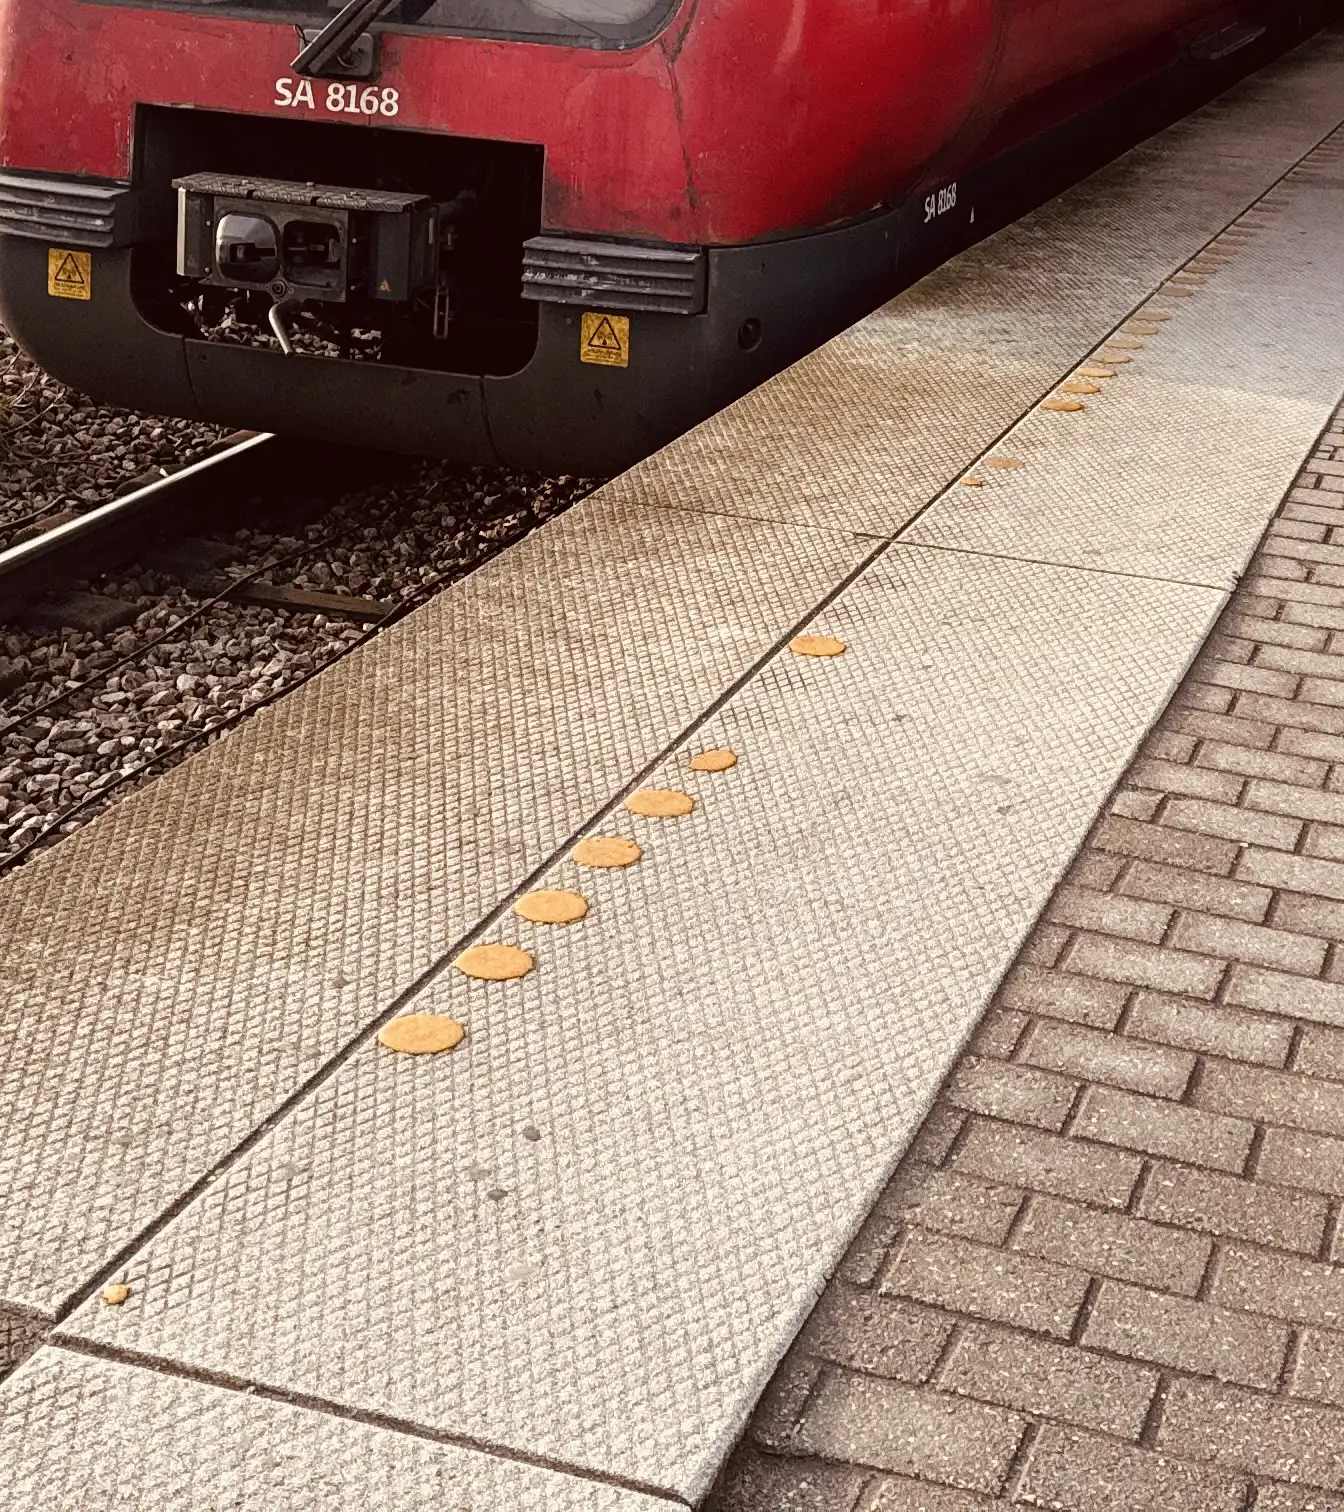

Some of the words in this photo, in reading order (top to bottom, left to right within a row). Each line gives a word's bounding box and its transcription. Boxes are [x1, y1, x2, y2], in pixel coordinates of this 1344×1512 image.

[274, 78, 316, 110] SA
[325, 82, 399, 117] 8168
[924, 194, 936, 224] SA
[938, 182, 957, 216] 8168
